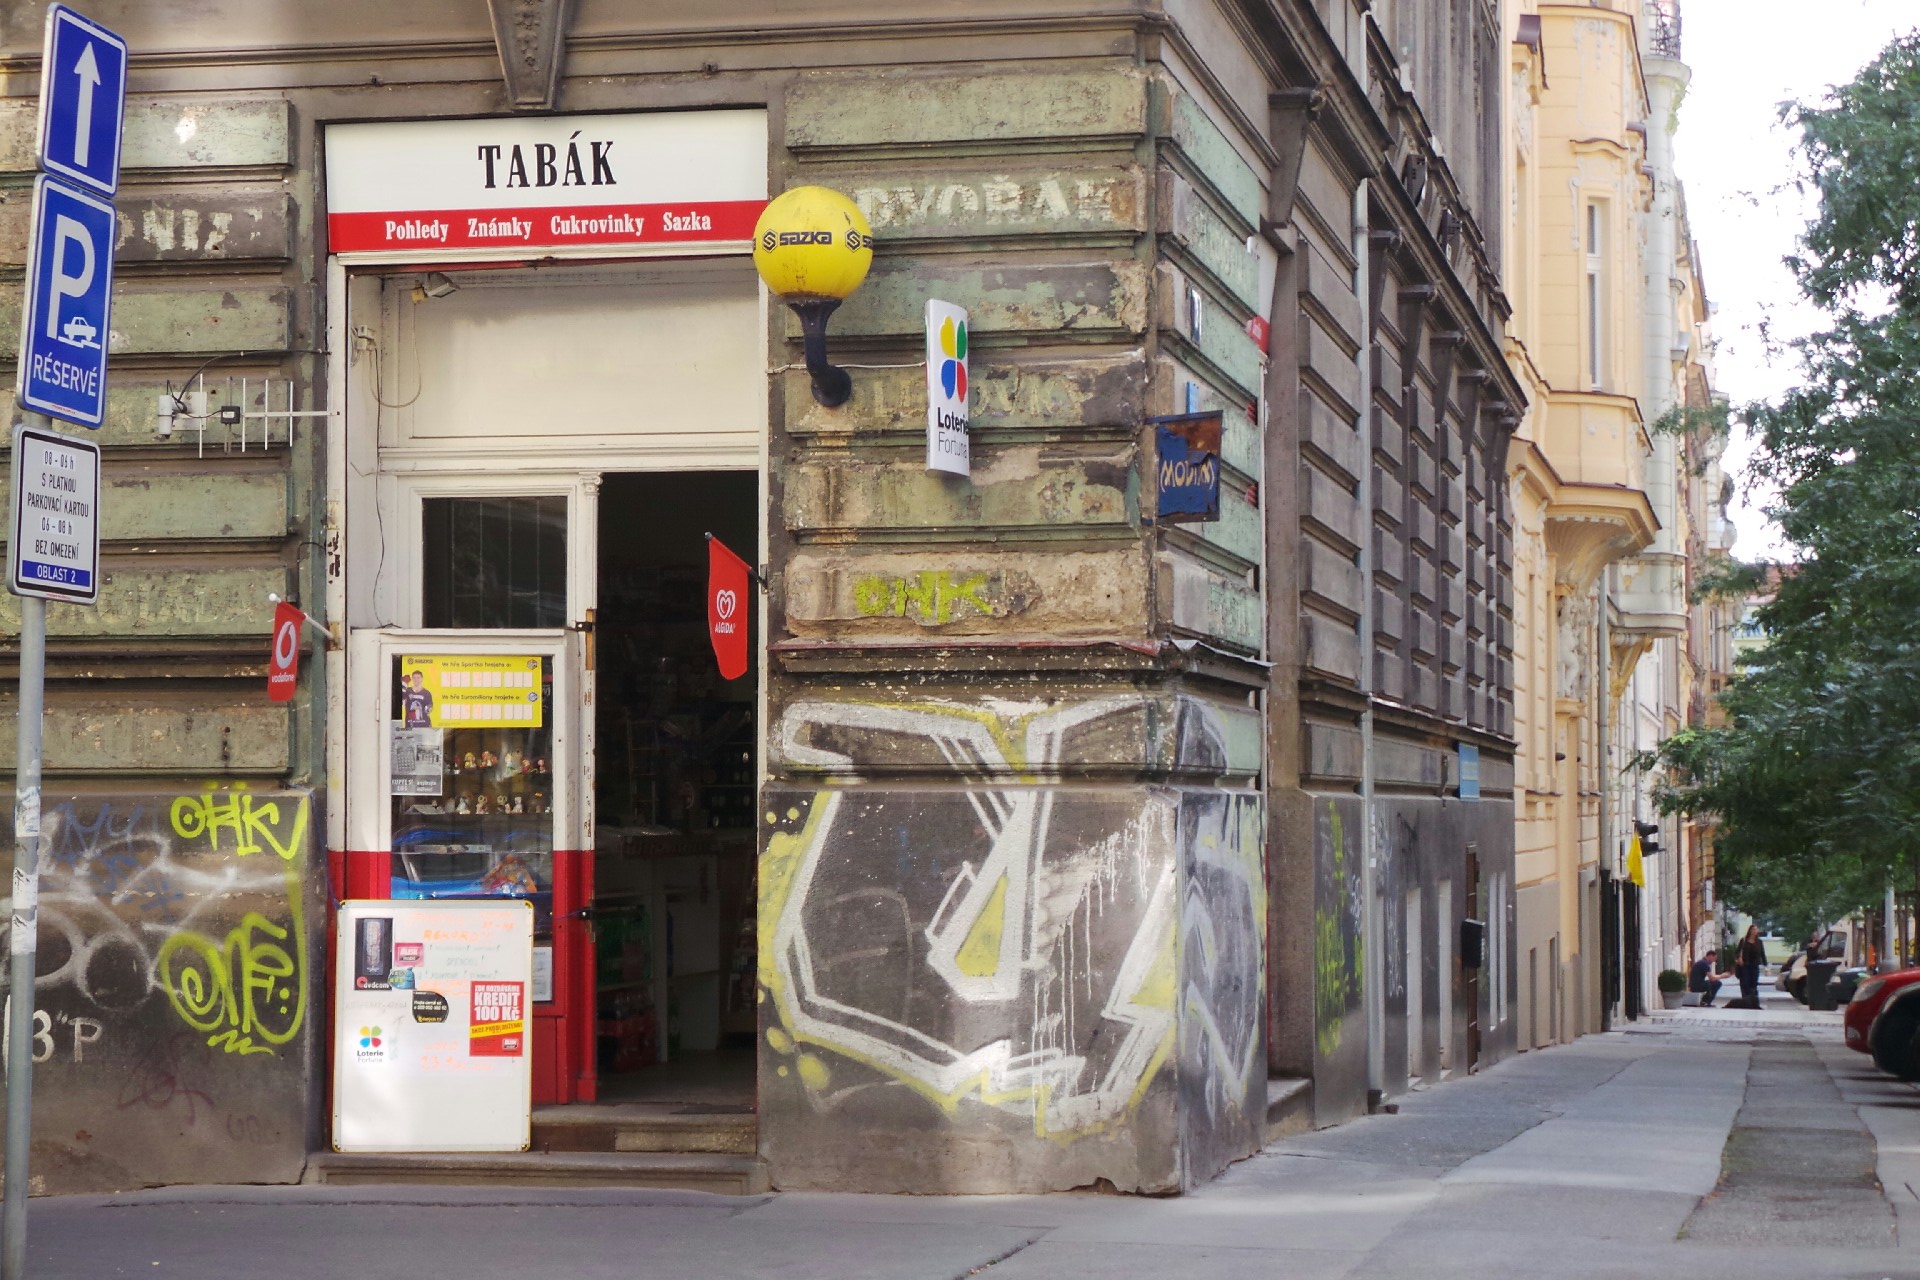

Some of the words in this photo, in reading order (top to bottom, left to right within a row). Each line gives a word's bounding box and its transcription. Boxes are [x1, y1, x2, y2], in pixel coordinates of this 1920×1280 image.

[478, 130, 617, 189] TABÁK
[385, 219, 449, 243] Pohledy
[467, 217, 532, 240] Známky
[550, 213, 645, 236] Cukrovinky
[662, 211, 712, 231] Sazka
[46, 213, 96, 339] P
[33, 352, 98, 397] RÉSERVÉ
[937, 407, 969, 436] Loterie
[938, 431, 968, 459] Fortuna
[41, 472, 46, 487] S
[48, 473, 77, 493] PLATNOU
[27, 491, 63, 513] PARKOVACÍ
[63, 500, 89, 518] KARTOU
[35, 539, 48, 556] BEZ
[50, 541, 80, 561] OMEZENÍ
[36, 564, 68, 582] OBLAST
[70, 570, 76, 583] 2
[474, 991, 521, 1007] KREDIT
[474, 1006, 500, 1021] 100
[501, 1006, 520, 1021] Kč
